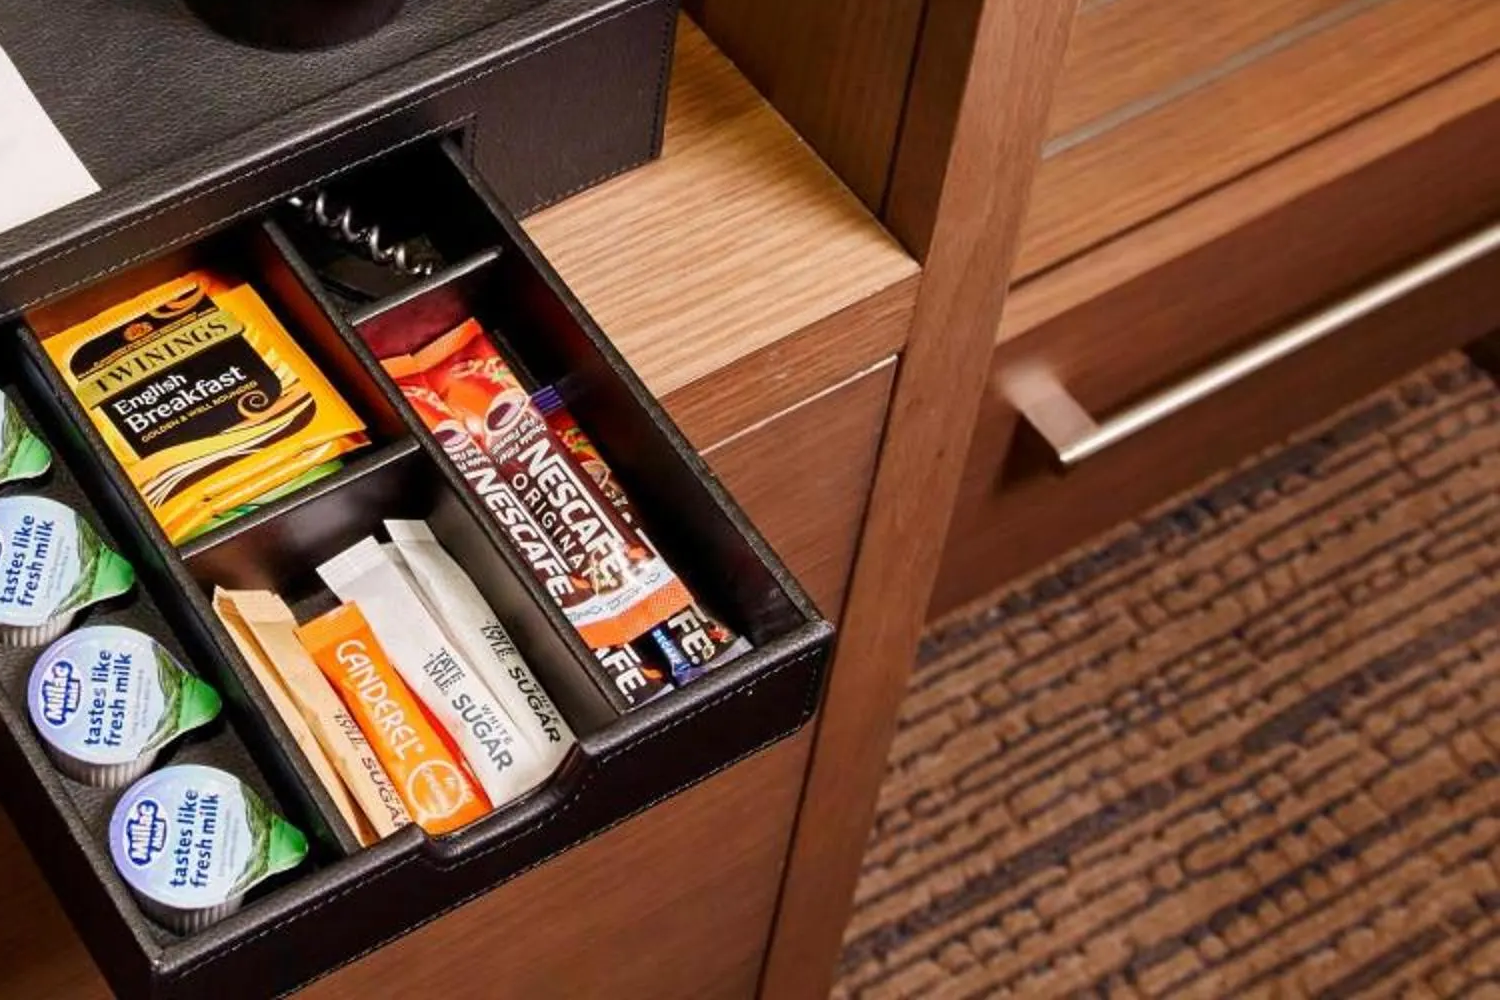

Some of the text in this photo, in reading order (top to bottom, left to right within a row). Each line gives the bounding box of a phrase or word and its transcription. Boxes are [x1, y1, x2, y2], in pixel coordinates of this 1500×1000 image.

[94, 321, 229, 393] TWININGS
[113, 373, 188, 416] English
[124, 365, 247, 434] Breakfast
[12, 515, 35, 549] like
[17, 520, 55, 607] fresh milk
[84, 650, 113, 746] tastes like
[104, 653, 132, 746] fresh milk
[336, 639, 417, 760] CANDEREL
[452, 693, 513, 772] SUGAR
[508, 666, 561, 744] SUGAR
[170, 789, 199, 887] tastes like
[190, 793, 219, 887] fresh milk
